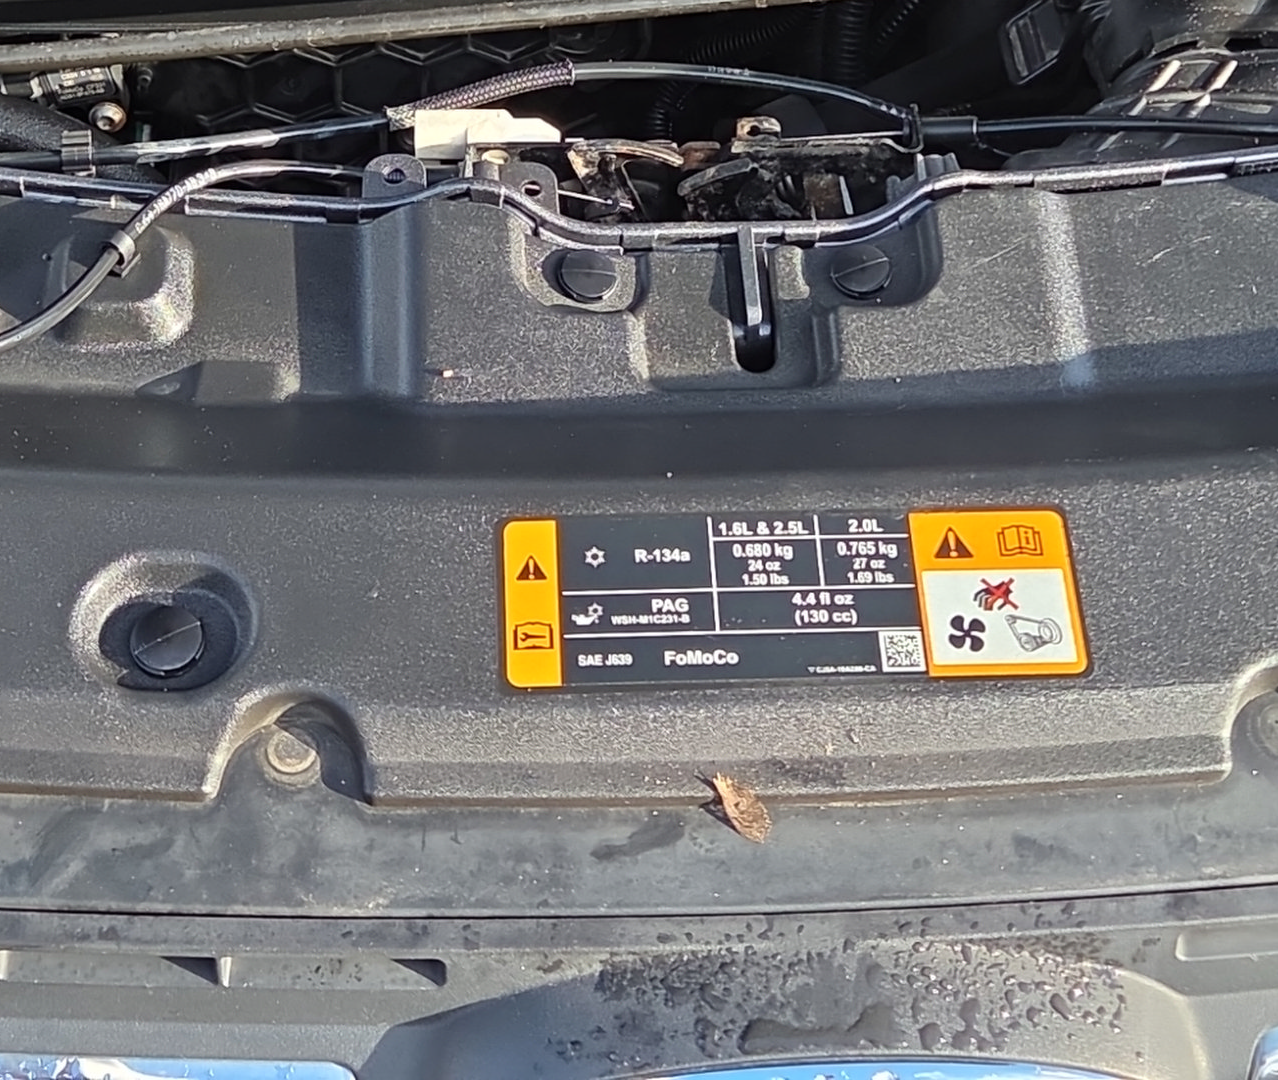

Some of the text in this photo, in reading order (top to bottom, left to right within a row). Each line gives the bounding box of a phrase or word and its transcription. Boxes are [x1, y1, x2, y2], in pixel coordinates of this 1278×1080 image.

[718, 520, 809, 536] 1.6L & 2.5L
[848, 519, 884, 533] 2.0L
[634, 548, 691, 563] R-134a
[732, 543, 794, 561] 0.680 kg
[836, 541, 898, 558] 0.765 kg
[747, 560, 782, 572] 24 oz
[853, 558, 886, 569] 27 oz
[742, 573, 790, 586] 1.50 lbs
[847, 571, 895, 584] 1.69 lbs
[651, 597, 690, 613] PAG
[791, 592, 854, 606] 4.4 fl oz
[794, 608, 858, 626] (130 cc)
[577, 653, 633, 667] SAE J639
[663, 649, 739, 667] FoMoCo
